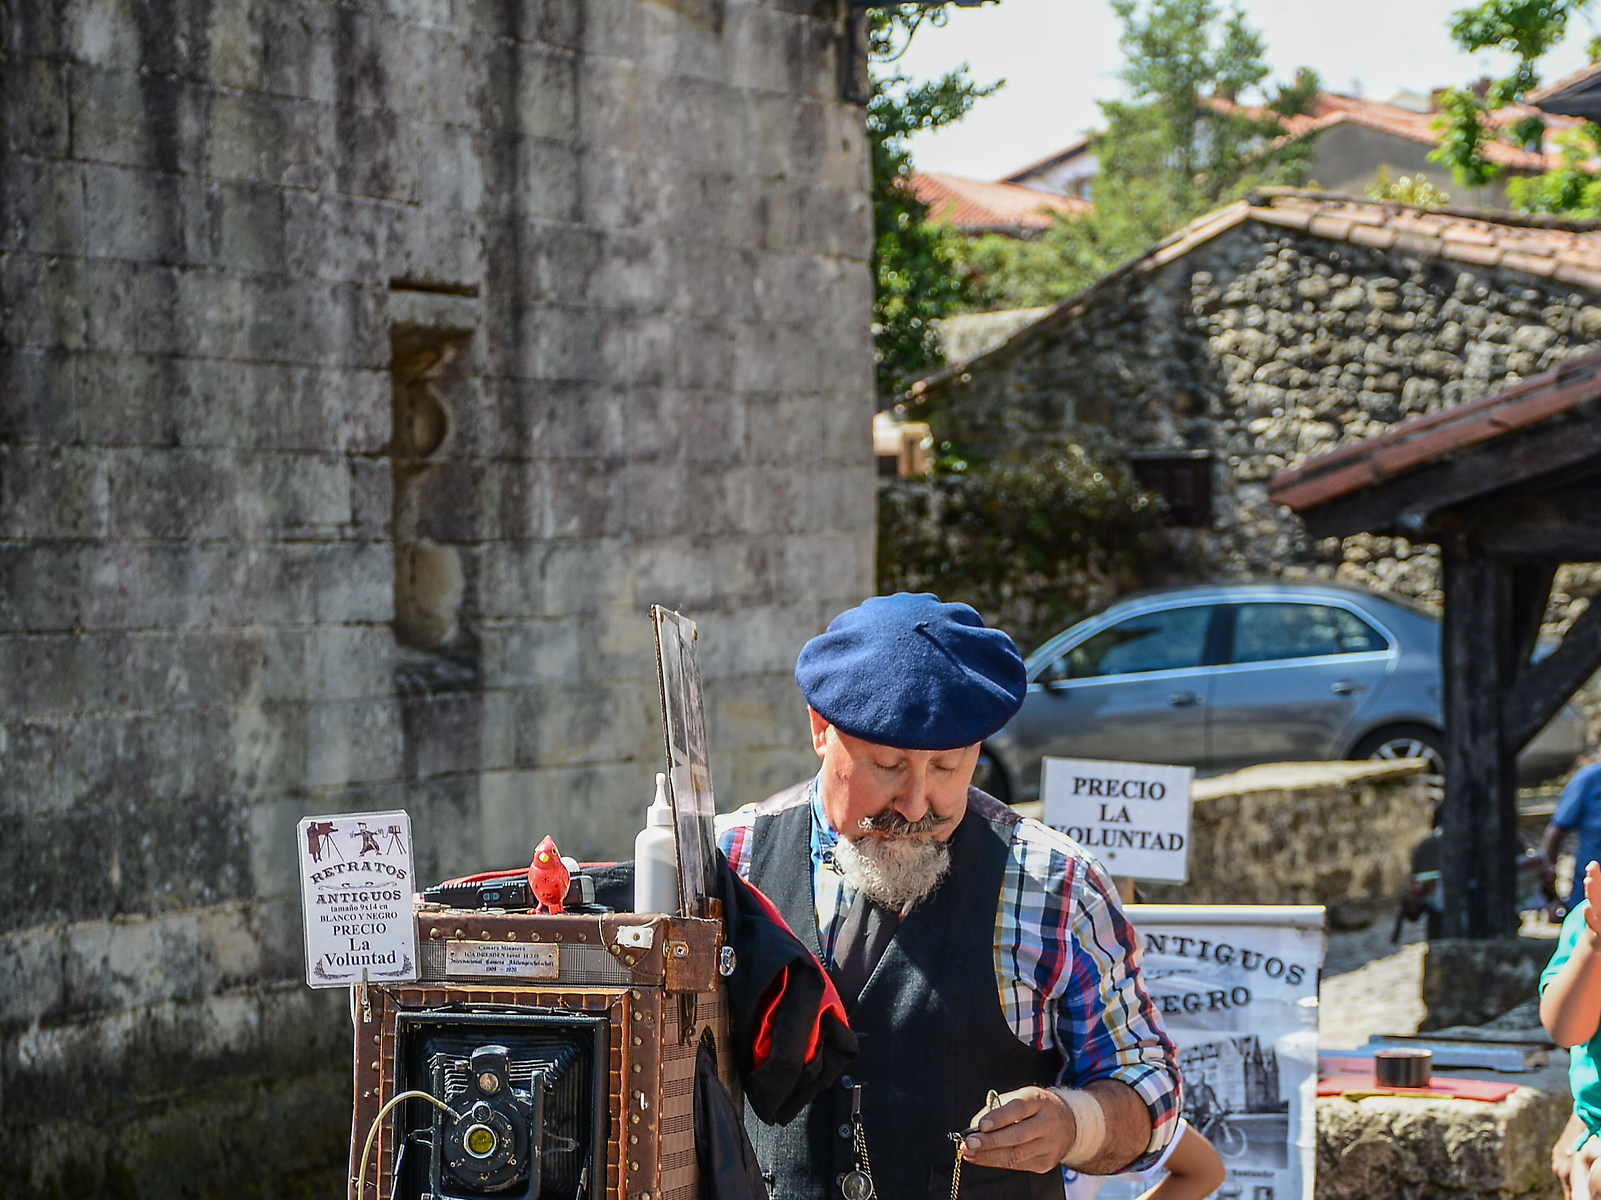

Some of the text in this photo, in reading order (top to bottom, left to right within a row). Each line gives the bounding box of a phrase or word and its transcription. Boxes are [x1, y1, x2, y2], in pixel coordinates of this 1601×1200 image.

[1072, 777, 1166, 801] PRECIO
[1098, 803, 1132, 823] LA
[310, 861, 407, 884] RETRATOS
[316, 890, 402, 905] ANTIGUOS
[331, 904, 359, 913] tamaño
[360, 903, 378, 912] 9x14
[320, 911, 398, 923] BLANCO Y NEGRO
[333, 922, 387, 936] PRECIO
[349, 937, 370, 952] La
[324, 950, 396, 967] Voluntad
[1144, 933, 1306, 986] NTIGUOS
[1150, 986, 1252, 1015] EGRO
